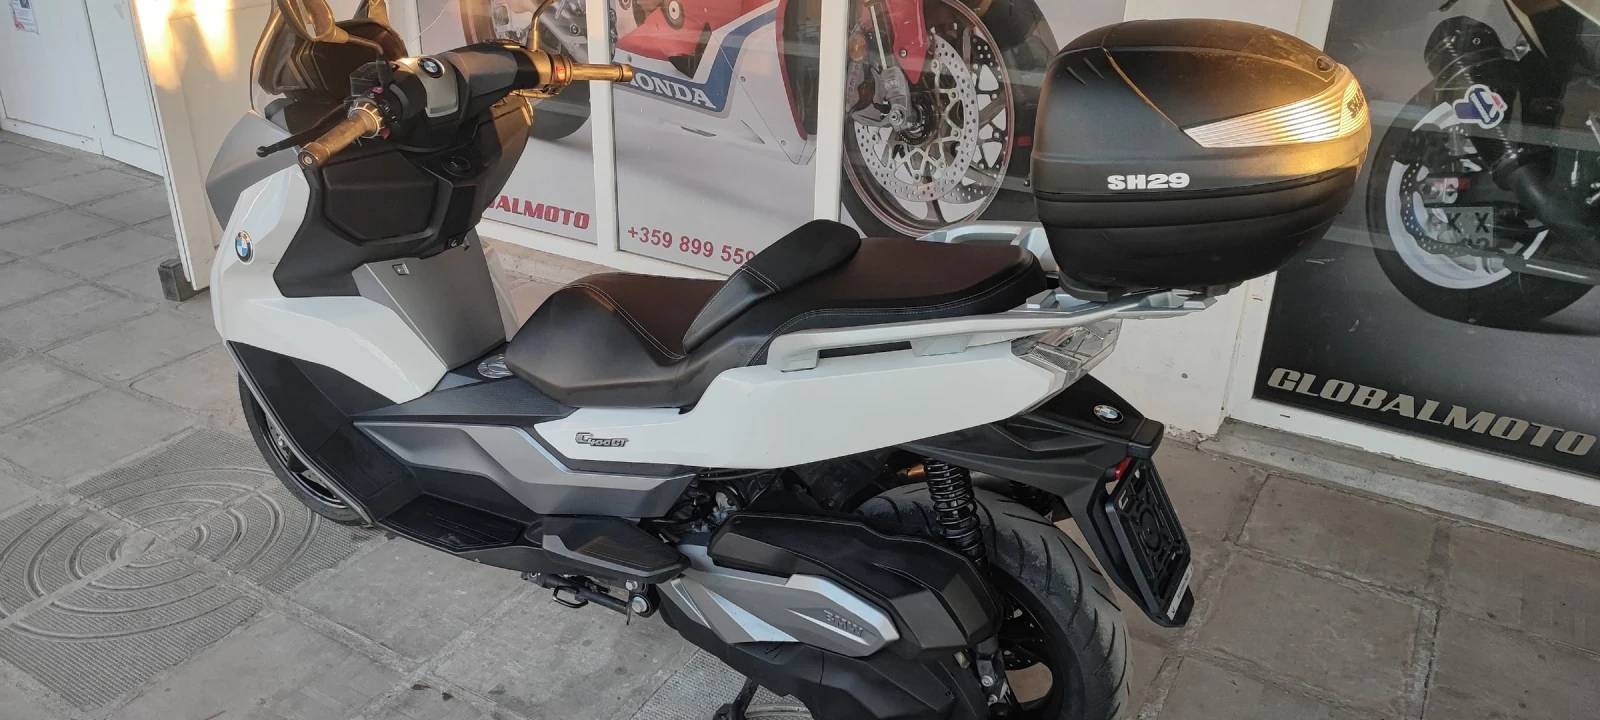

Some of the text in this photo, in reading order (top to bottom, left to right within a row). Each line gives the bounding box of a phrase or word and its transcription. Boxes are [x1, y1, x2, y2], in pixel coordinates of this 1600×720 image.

[1107, 172, 1190, 190] SH29
[488, 195, 590, 230] ALMOTO
[627, 226, 673, 249] +359
[679, 235, 714, 258] 899
[1267, 367, 1597, 456] GLOBALMOTO
[823, 609, 864, 638] BMW
